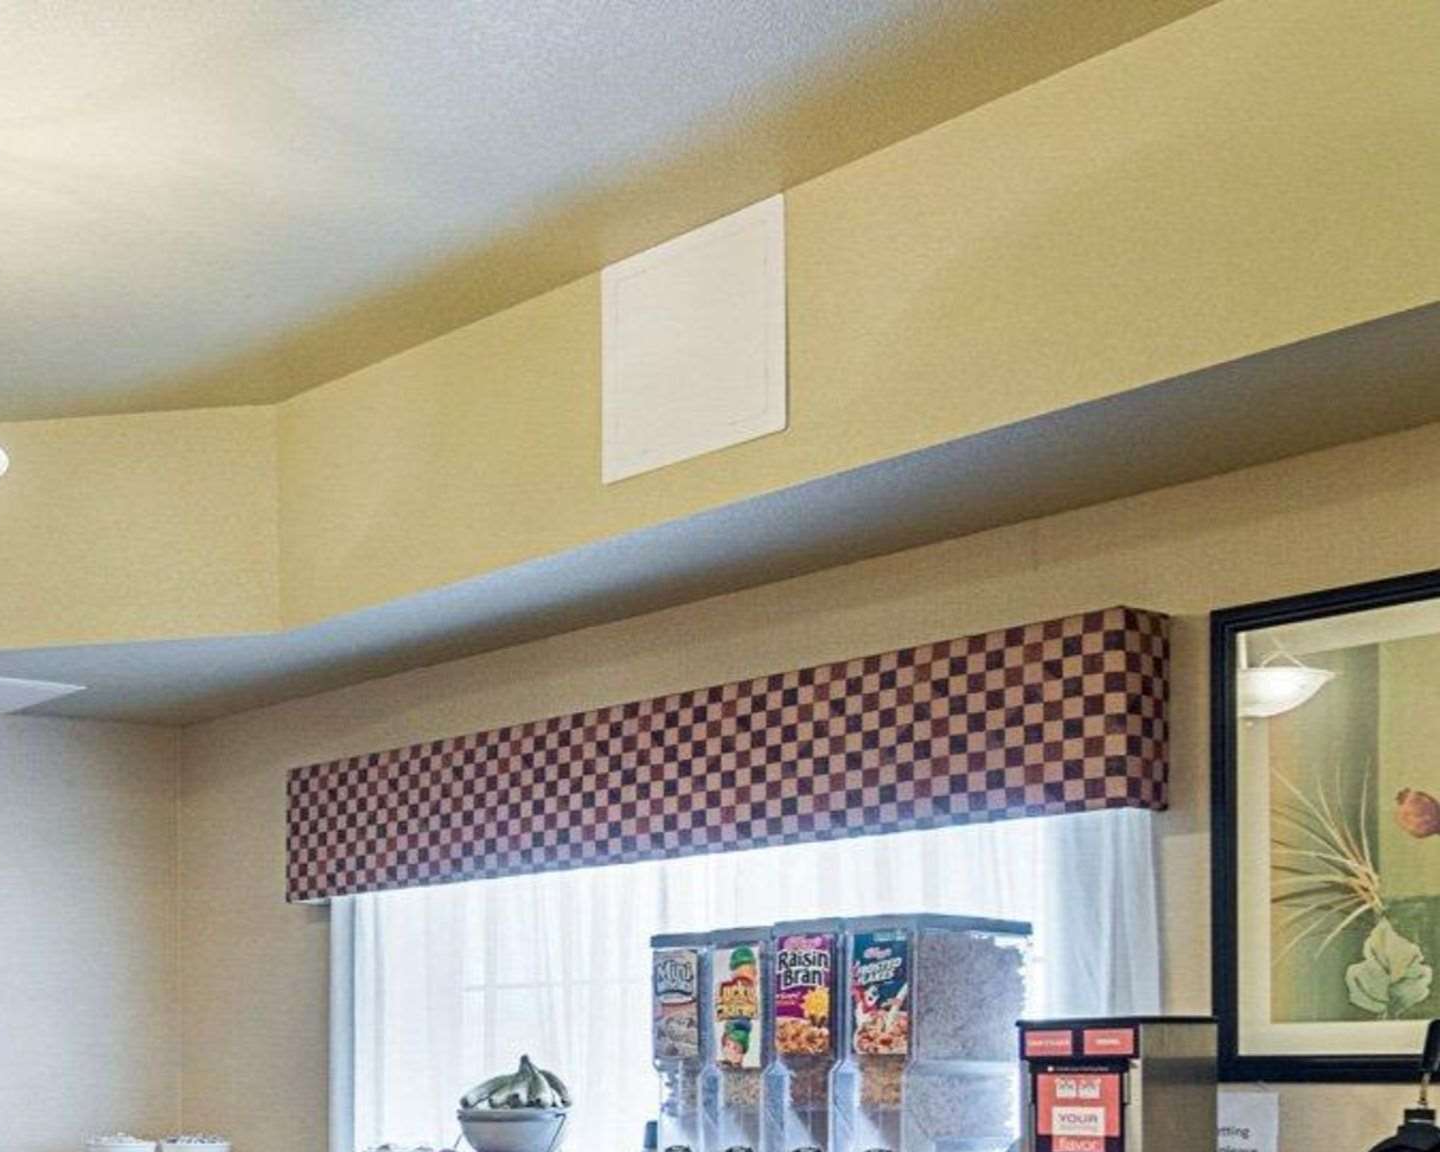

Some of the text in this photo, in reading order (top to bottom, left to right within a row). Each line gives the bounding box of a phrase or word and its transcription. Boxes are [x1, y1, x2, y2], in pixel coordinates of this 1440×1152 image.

[777, 950, 829, 970] Raisin
[782, 968, 823, 986] Bran
[1057, 1113, 1099, 1124] YOUR
